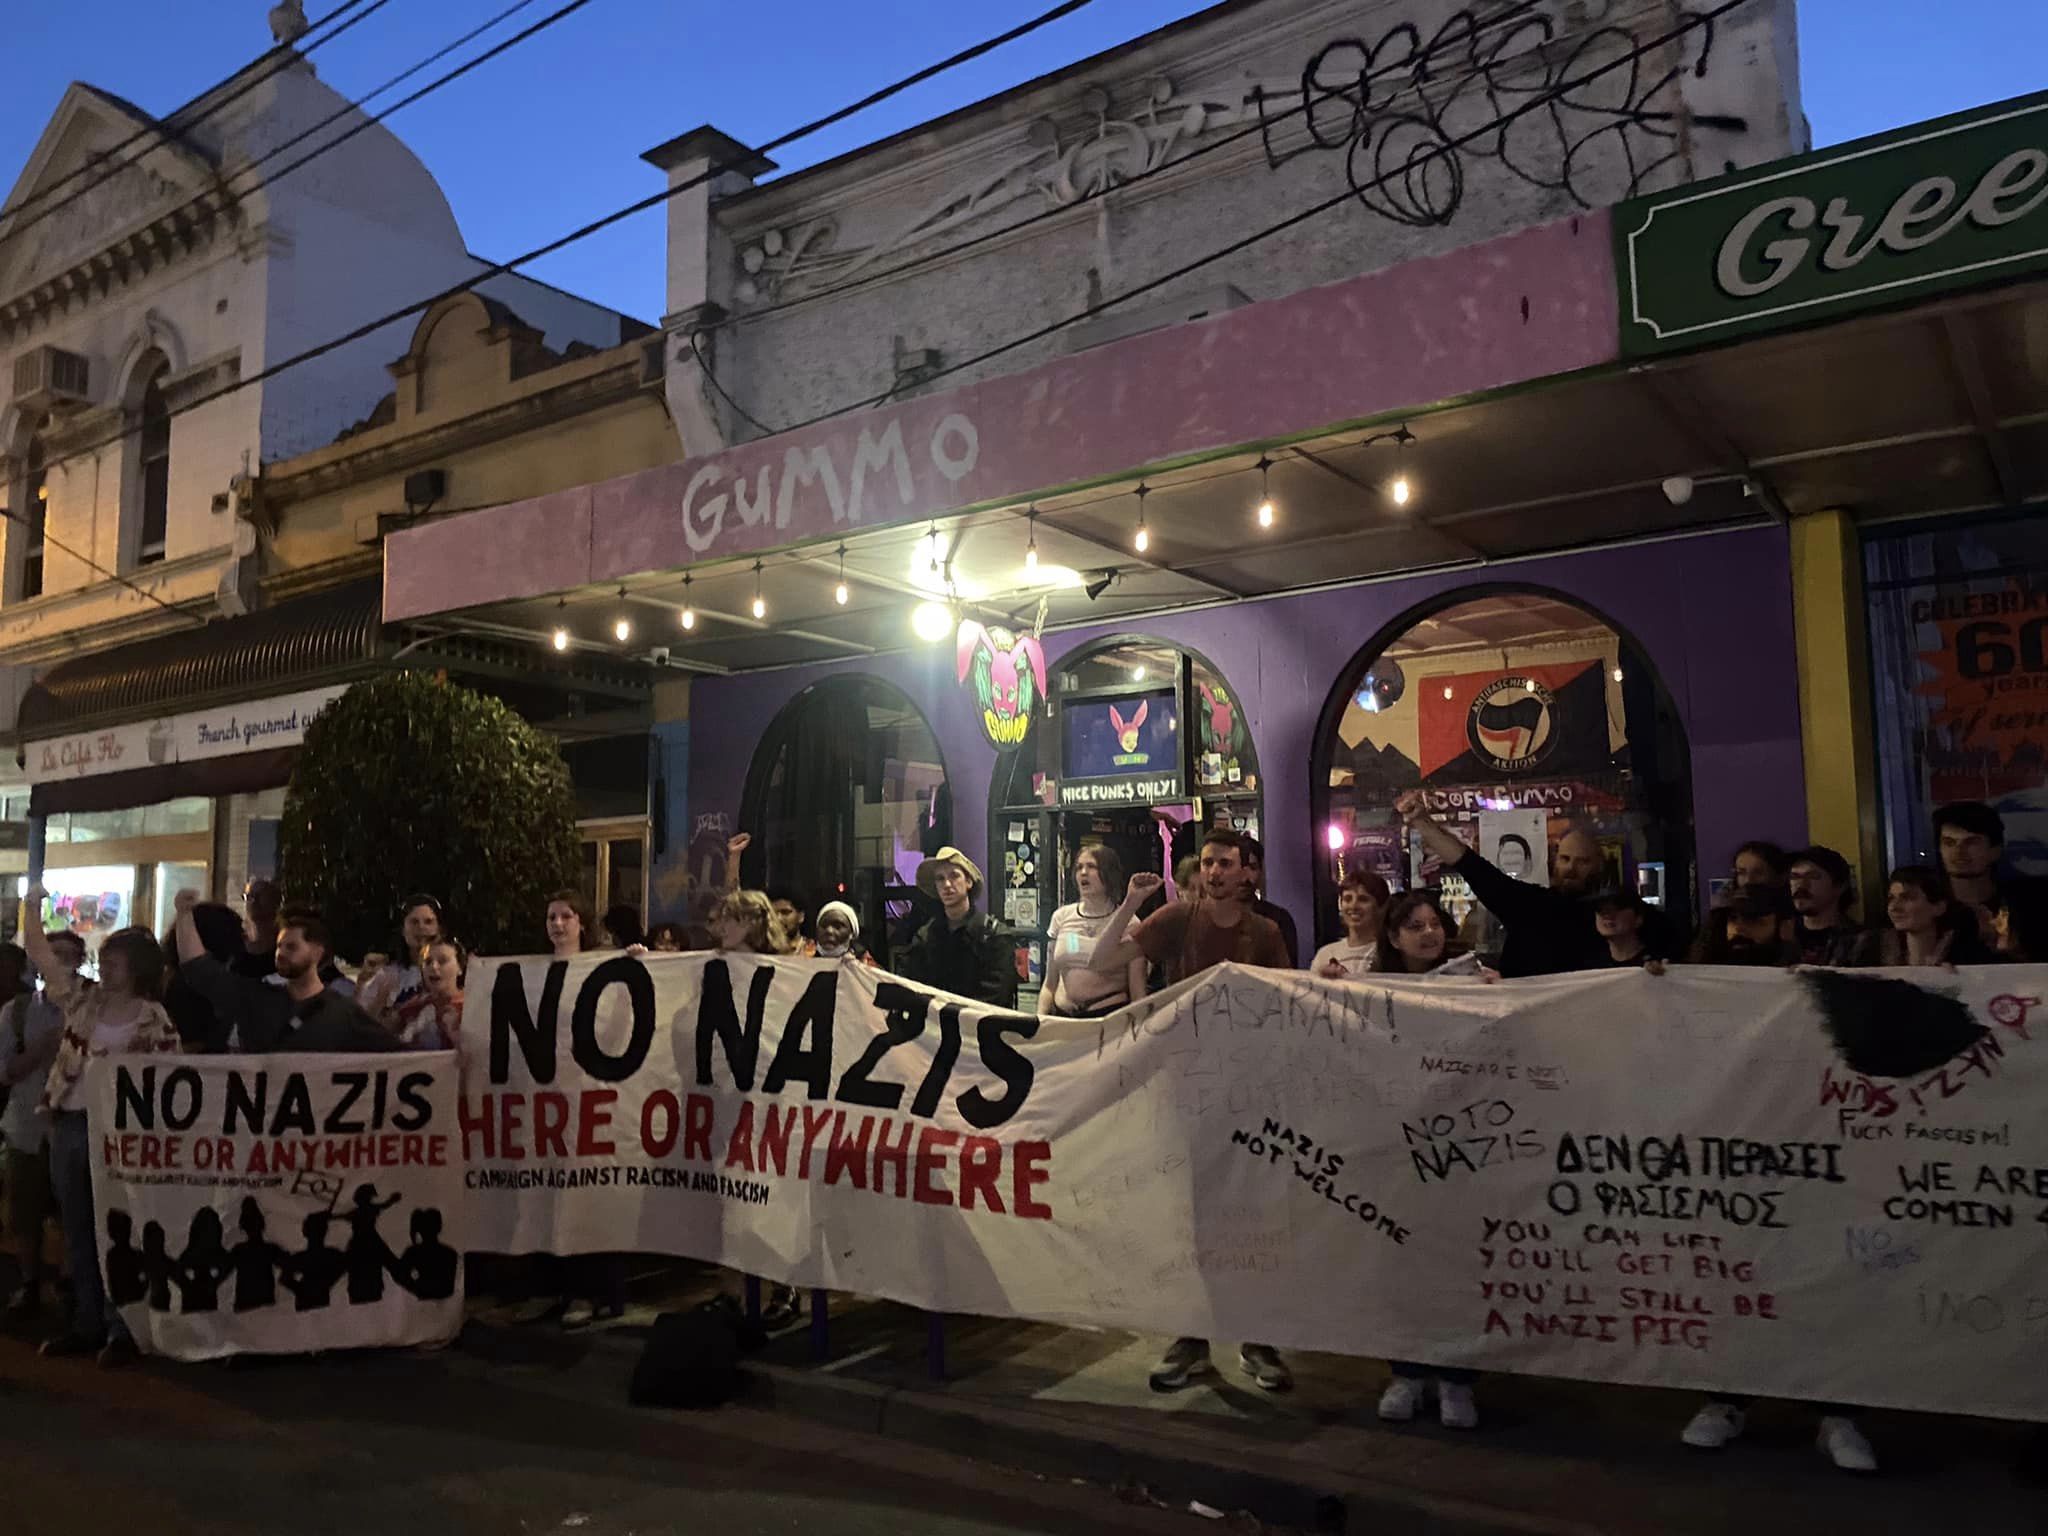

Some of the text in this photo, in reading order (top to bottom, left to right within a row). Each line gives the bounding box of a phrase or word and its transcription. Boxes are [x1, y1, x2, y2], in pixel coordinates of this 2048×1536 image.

[198, 719, 240, 745] French
[243, 711, 298, 745] gourmet
[1492, 755, 1537, 769] AKTION
[1062, 785, 1090, 805] NICE
[1137, 779, 1177, 805] ONLY!
[489, 956, 1040, 1130] NO NAZIS
[115, 1065, 436, 1137] NO NAZIS
[1402, 1099, 1514, 1146] NO TO
[104, 1133, 448, 1174] HERE OR ANYWHERE
[457, 1089, 1053, 1220] HERE OR ANYWHERE
[1262, 1117, 1345, 1177] NAZIS
[1411, 1129, 1546, 1183] NAZIS
[465, 1165, 770, 1205] CAMPAIGN AGAINST RACISM AND FASCISM
[1232, 1128, 1412, 1245] NOT WELCOME
[1897, 1162, 2048, 1199] WE ARE
[1884, 1196, 2014, 1229] COMIN
[1482, 1217, 1724, 1251] YOU CAN LIFT
[1480, 1247, 1755, 1282] YOU'LL GET BIG
[1619, 1286, 1714, 1315] STILL
[1734, 1293, 1779, 1320] BE
[1484, 1308, 1712, 1351] A NAZI PIG
